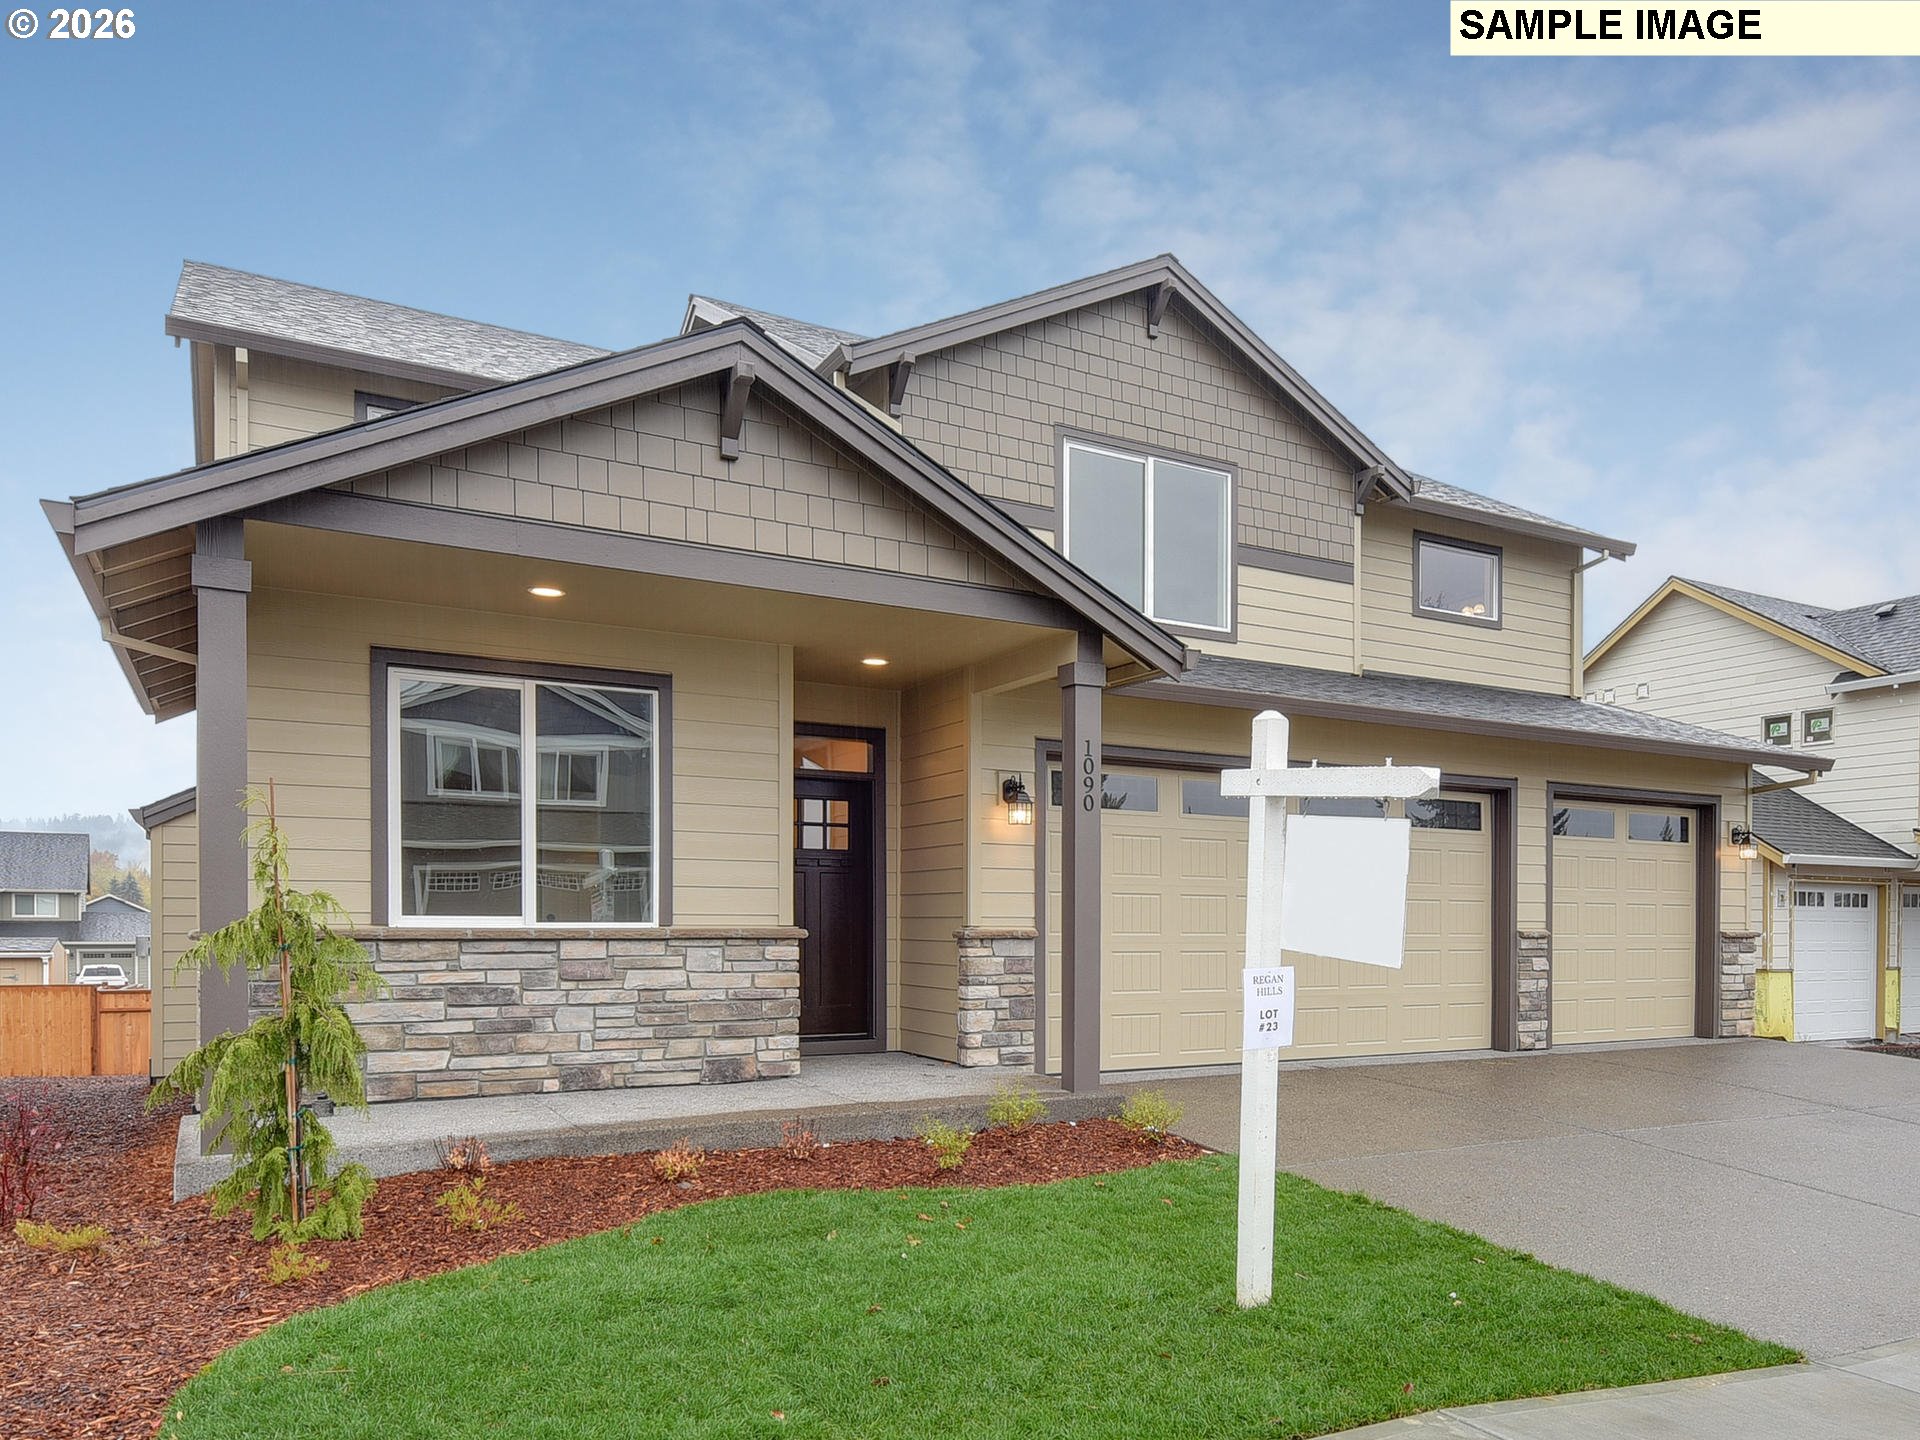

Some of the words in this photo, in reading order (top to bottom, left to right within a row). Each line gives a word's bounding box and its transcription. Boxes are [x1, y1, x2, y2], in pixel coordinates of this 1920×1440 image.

[1083, 739, 1095, 812] 1090
[1252, 974, 1284, 985] REGAN
[1256, 986, 1283, 997] HILLS
[1259, 1009, 1279, 1020] LOT
[1258, 1021, 1279, 1032] #23
